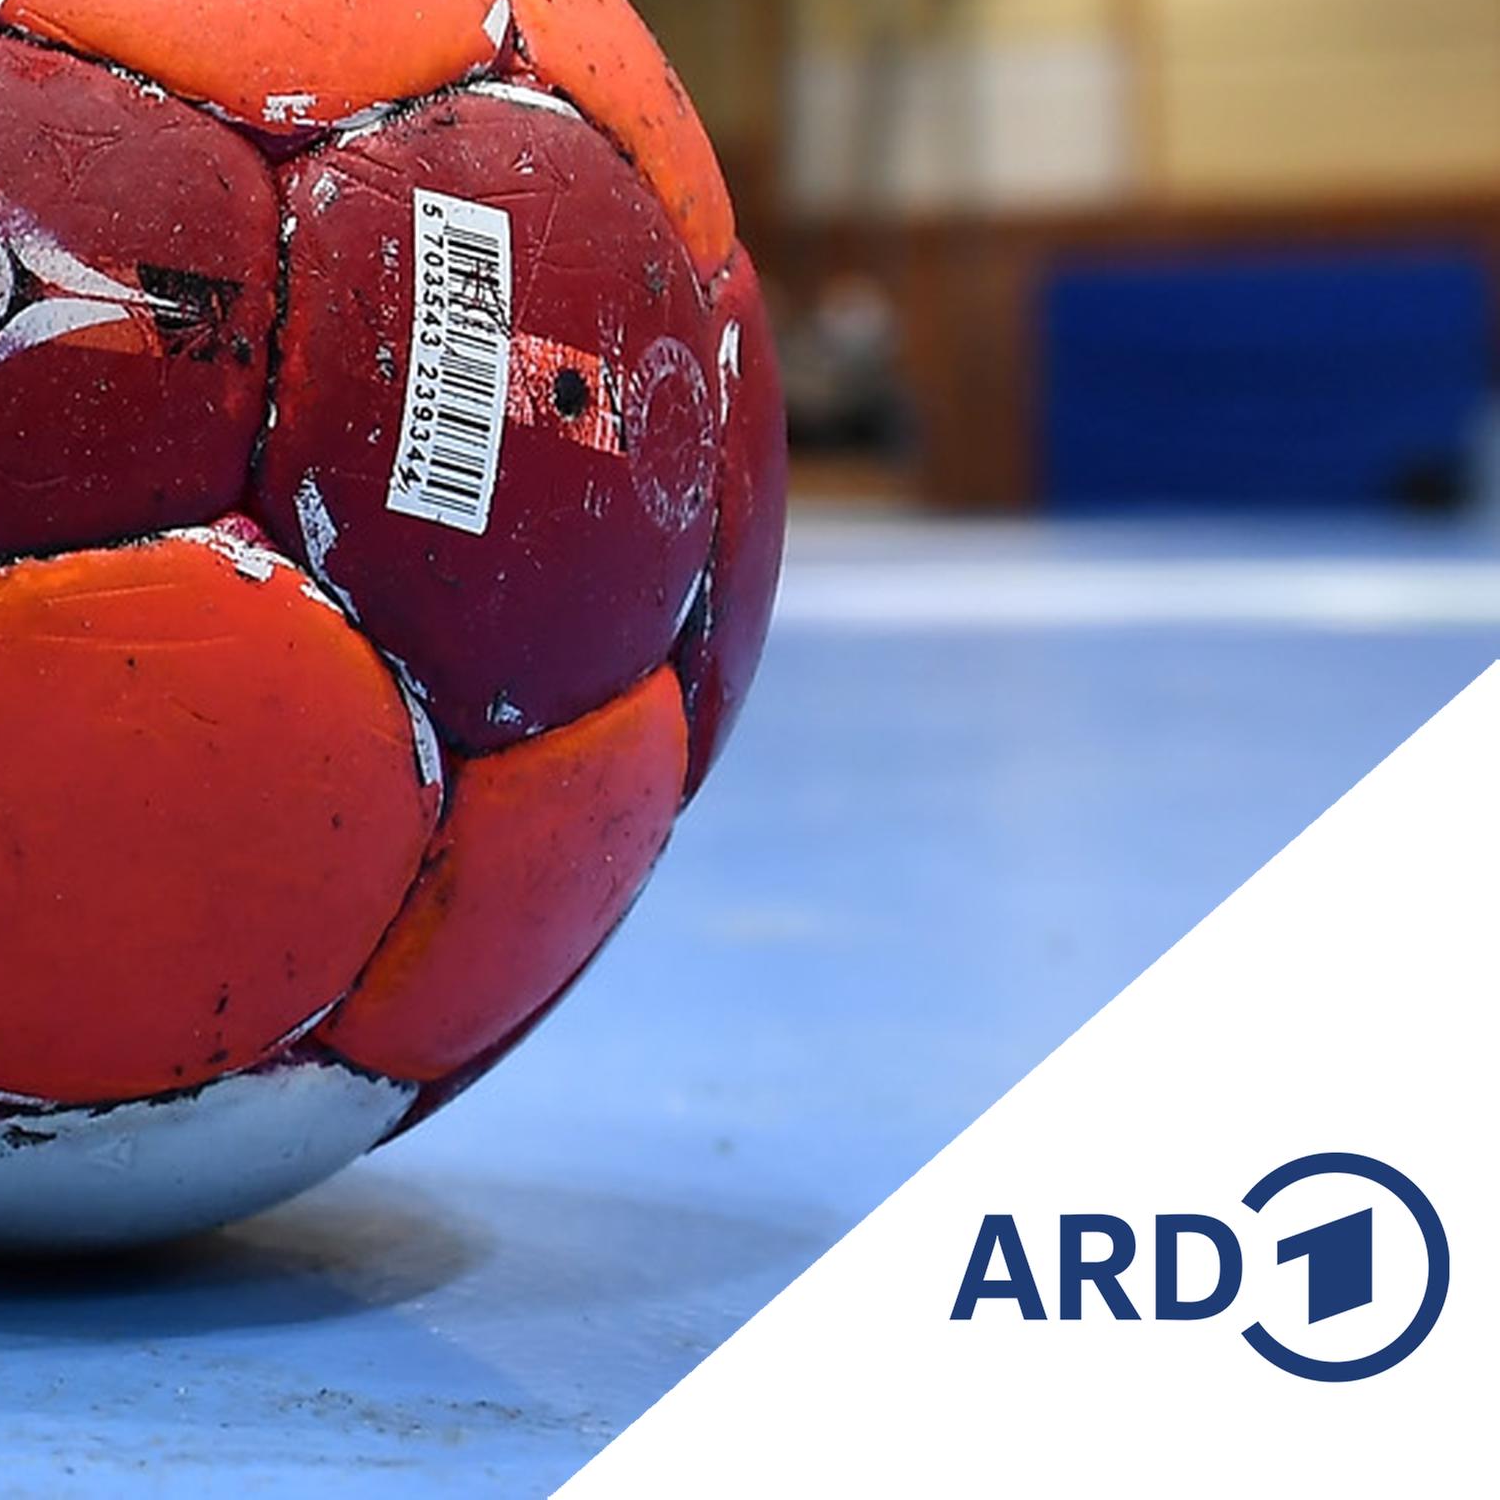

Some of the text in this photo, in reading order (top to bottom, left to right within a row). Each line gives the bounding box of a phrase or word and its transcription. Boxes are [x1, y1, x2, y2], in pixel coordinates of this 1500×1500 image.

[402, 202, 445, 484] 5 703543 239344
